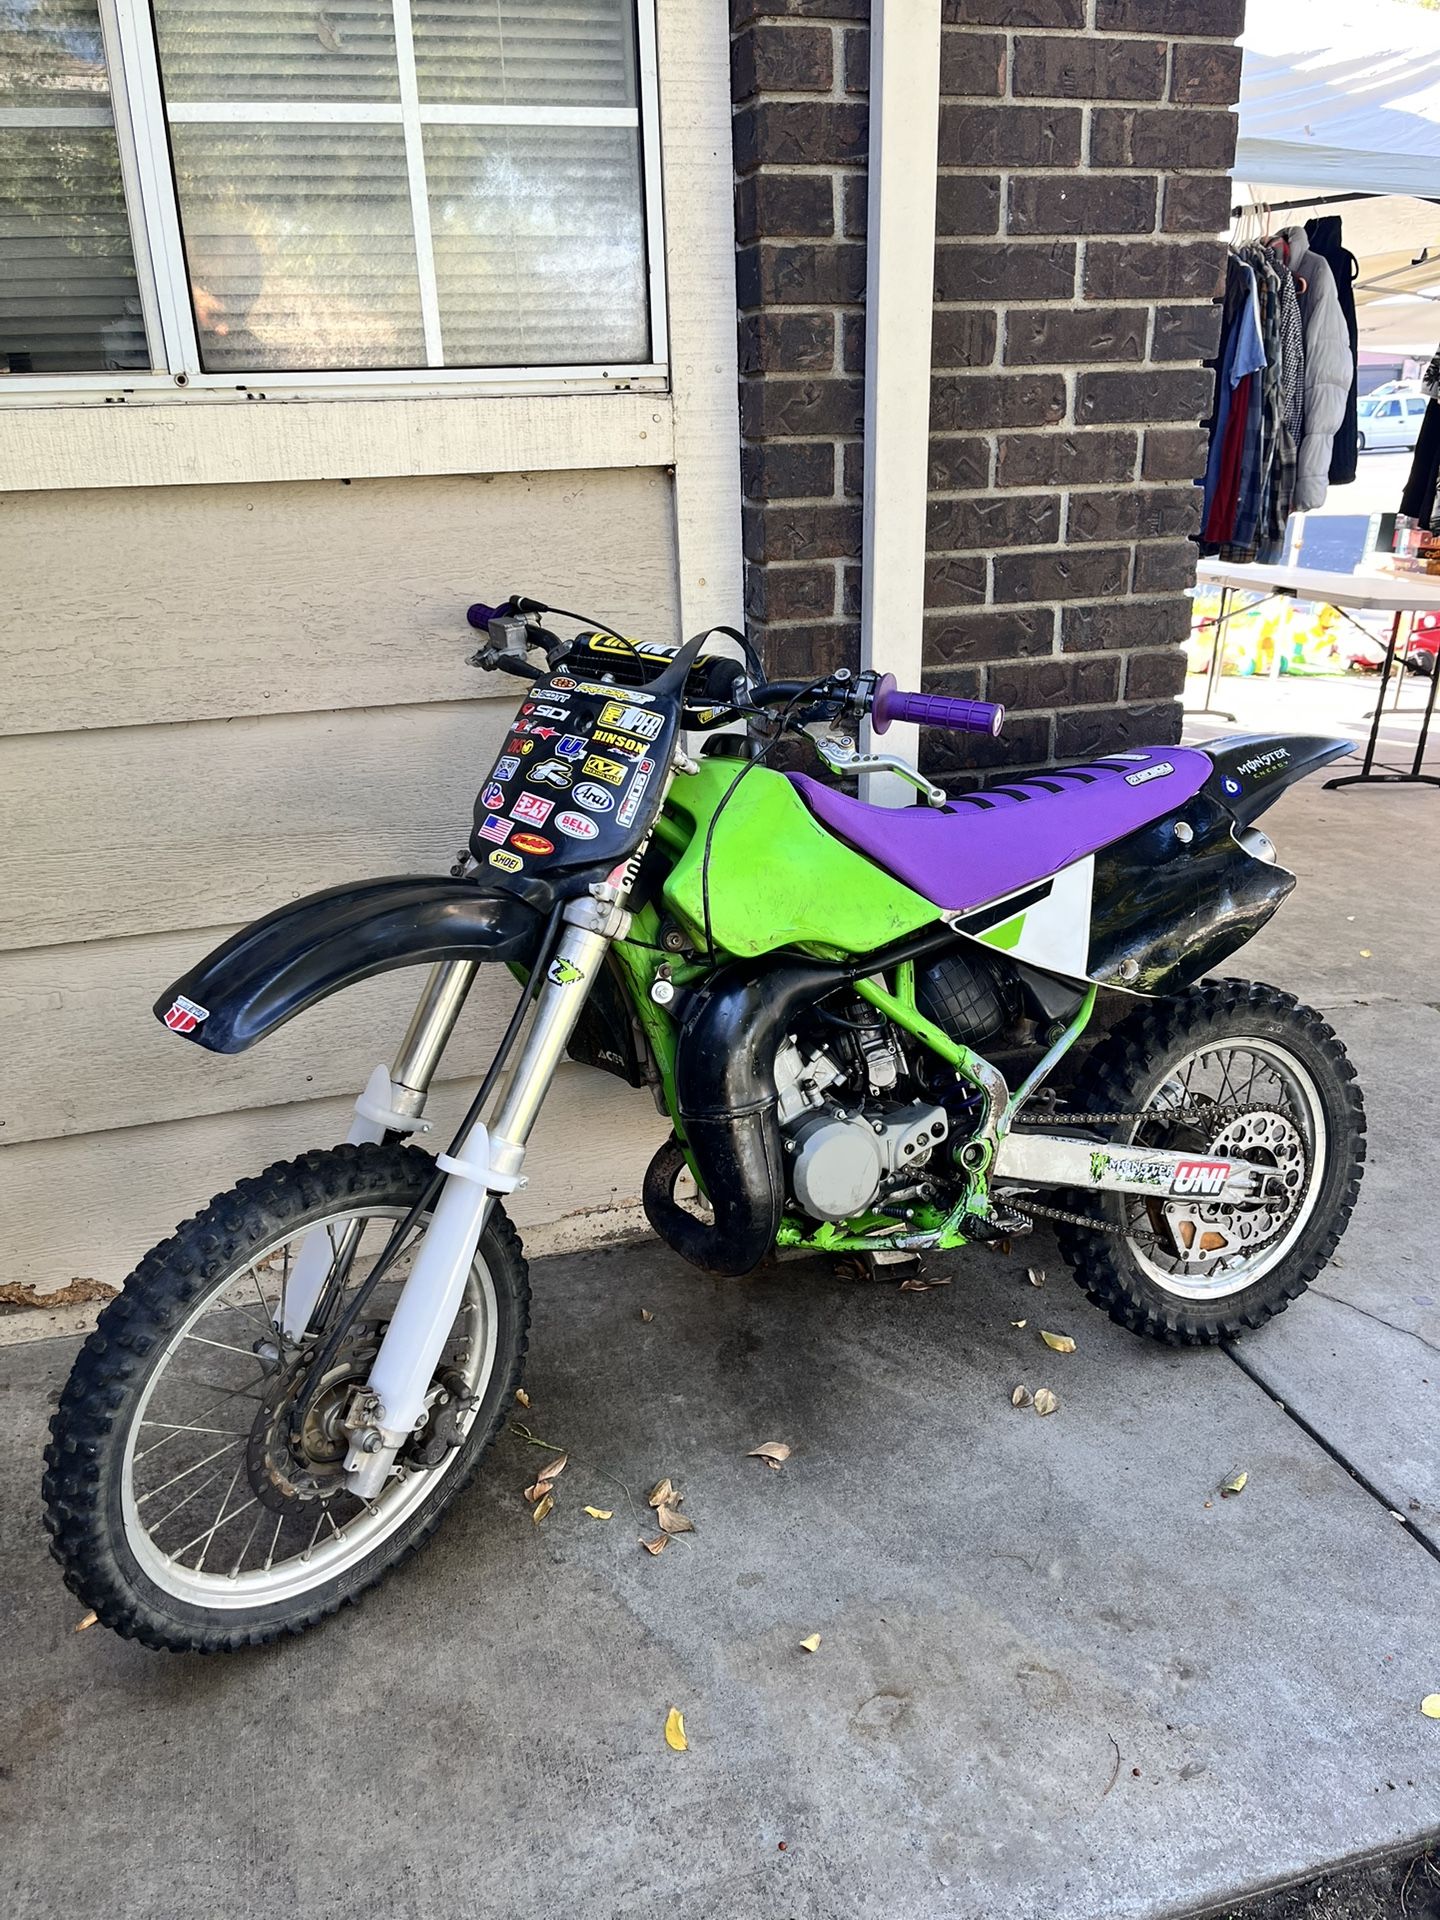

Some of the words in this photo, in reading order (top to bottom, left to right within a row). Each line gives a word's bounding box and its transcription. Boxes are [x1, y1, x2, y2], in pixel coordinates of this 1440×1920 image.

[540, 690, 570, 702] SCOTT
[592, 730, 647, 754] HINSON
[1236, 747, 1291, 775] MONSTER
[575, 787, 609, 806] Arai
[562, 815, 592, 834] BELL
[493, 853, 519, 870] SHOEI
[1109, 1159, 1175, 1178] MONSTER
[1173, 1167, 1228, 1193] UNI
